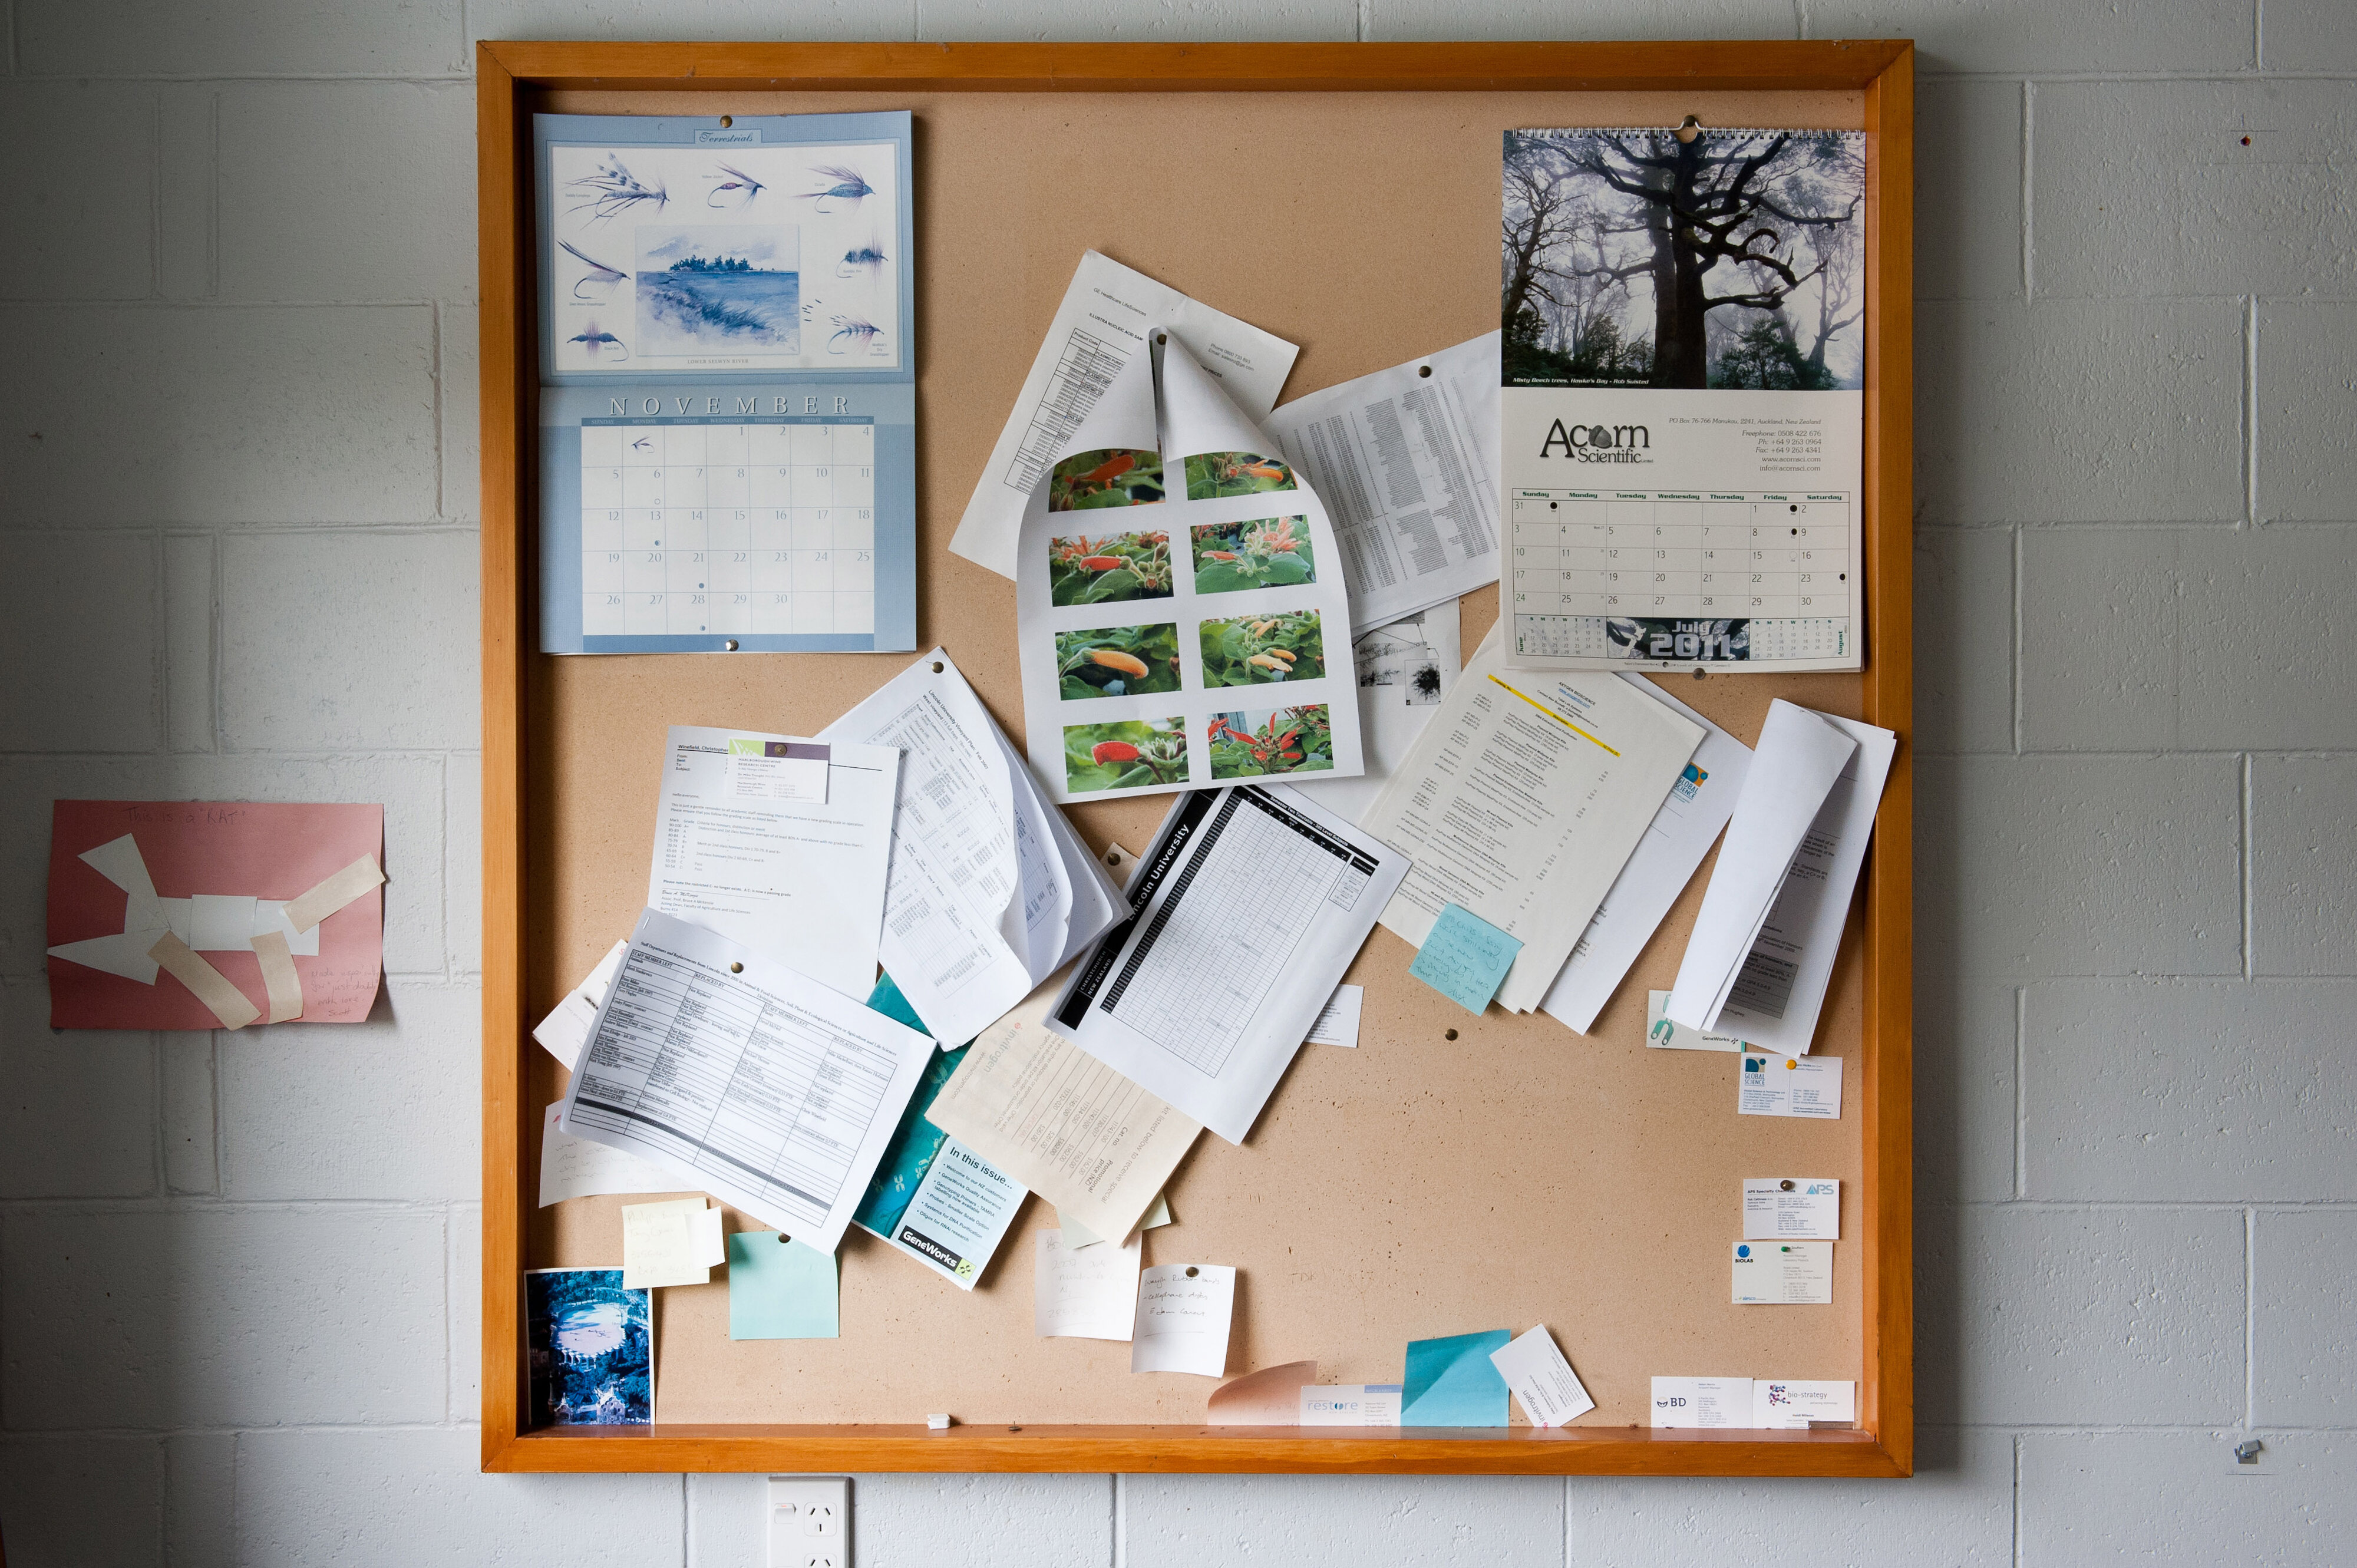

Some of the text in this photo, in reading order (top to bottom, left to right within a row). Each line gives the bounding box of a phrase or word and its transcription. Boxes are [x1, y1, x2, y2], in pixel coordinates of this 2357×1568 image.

[699, 131, 754, 143] Terrestrials
[1100, 291, 1121, 304] Healthcare
[1121, 301, 1146, 316] LifeSciences
[1074, 331, 1088, 341] Product
[1107, 322, 1124, 332] NUCLEIC
[609, 396, 850, 415] NOVEMBER
[1578, 448, 1641, 463] Scientific
[1516, 593, 1811, 606] 24 25 26 27 28 29 30
[1671, 622, 1708, 635] July
[1650, 633, 1731, 658] 2011
[922, 694, 943, 720] West vineyard
[927, 689, 941, 705] Lincoln
[939, 704, 956, 724] University
[955, 723, 969, 741] Vineyard
[980, 760, 988, 769] 2007
[1674, 782, 1695, 799] SCIENCE
[1677, 777, 1698, 794] GLOBAL
[122, 806, 152, 821] This
[1150, 824, 1189, 879] University
[1080, 950, 1105, 991] CHRISTCHURCH
[1087, 958, 1111, 995] NEW ZEALAND
[984, 1029, 1021, 1074] invitrogen
[950, 1052, 986, 1100] www.invitrogen.com
[1150, 1114, 1164, 1131] listed
[1161, 1105, 1170, 1115] kit
[1111, 1126, 1128, 1146] Cat. no.
[1136, 1131, 1152, 1151] below
[949, 1146, 1012, 1189] In this issue...
[1084, 1158, 1105, 1186] price (NZ)
[1087, 1159, 1113, 1193] Promotional
[1115, 1159, 1133, 1181] receive
[941, 1173, 1001, 1210] GeneWorks Quality Assurance
[946, 1164, 965, 1177] Welcome
[985, 1187, 1006, 1201] customers
[1101, 1181, 1117, 1203] special
[1806, 1184, 1834, 1194] APS
[934, 1185, 952, 1198] labelling
[961, 1201, 979, 1213] available
[936, 1180, 995, 1217] Genotyping Primers TAMRA
[923, 1202, 942, 1215] Systems
[949, 1216, 959, 1224] DNA
[959, 1222, 982, 1238] Purification
[929, 1193, 989, 1230] Probes Smaller Scale Option
[919, 1210, 933, 1221] Oligos
[940, 1222, 950, 1231] RNAi
[950, 1229, 969, 1242] research
[902, 1229, 958, 1267] GeneWorks
[1523, 1389, 1546, 1424] invitrogen
[1670, 1398, 1686, 1407] BD
